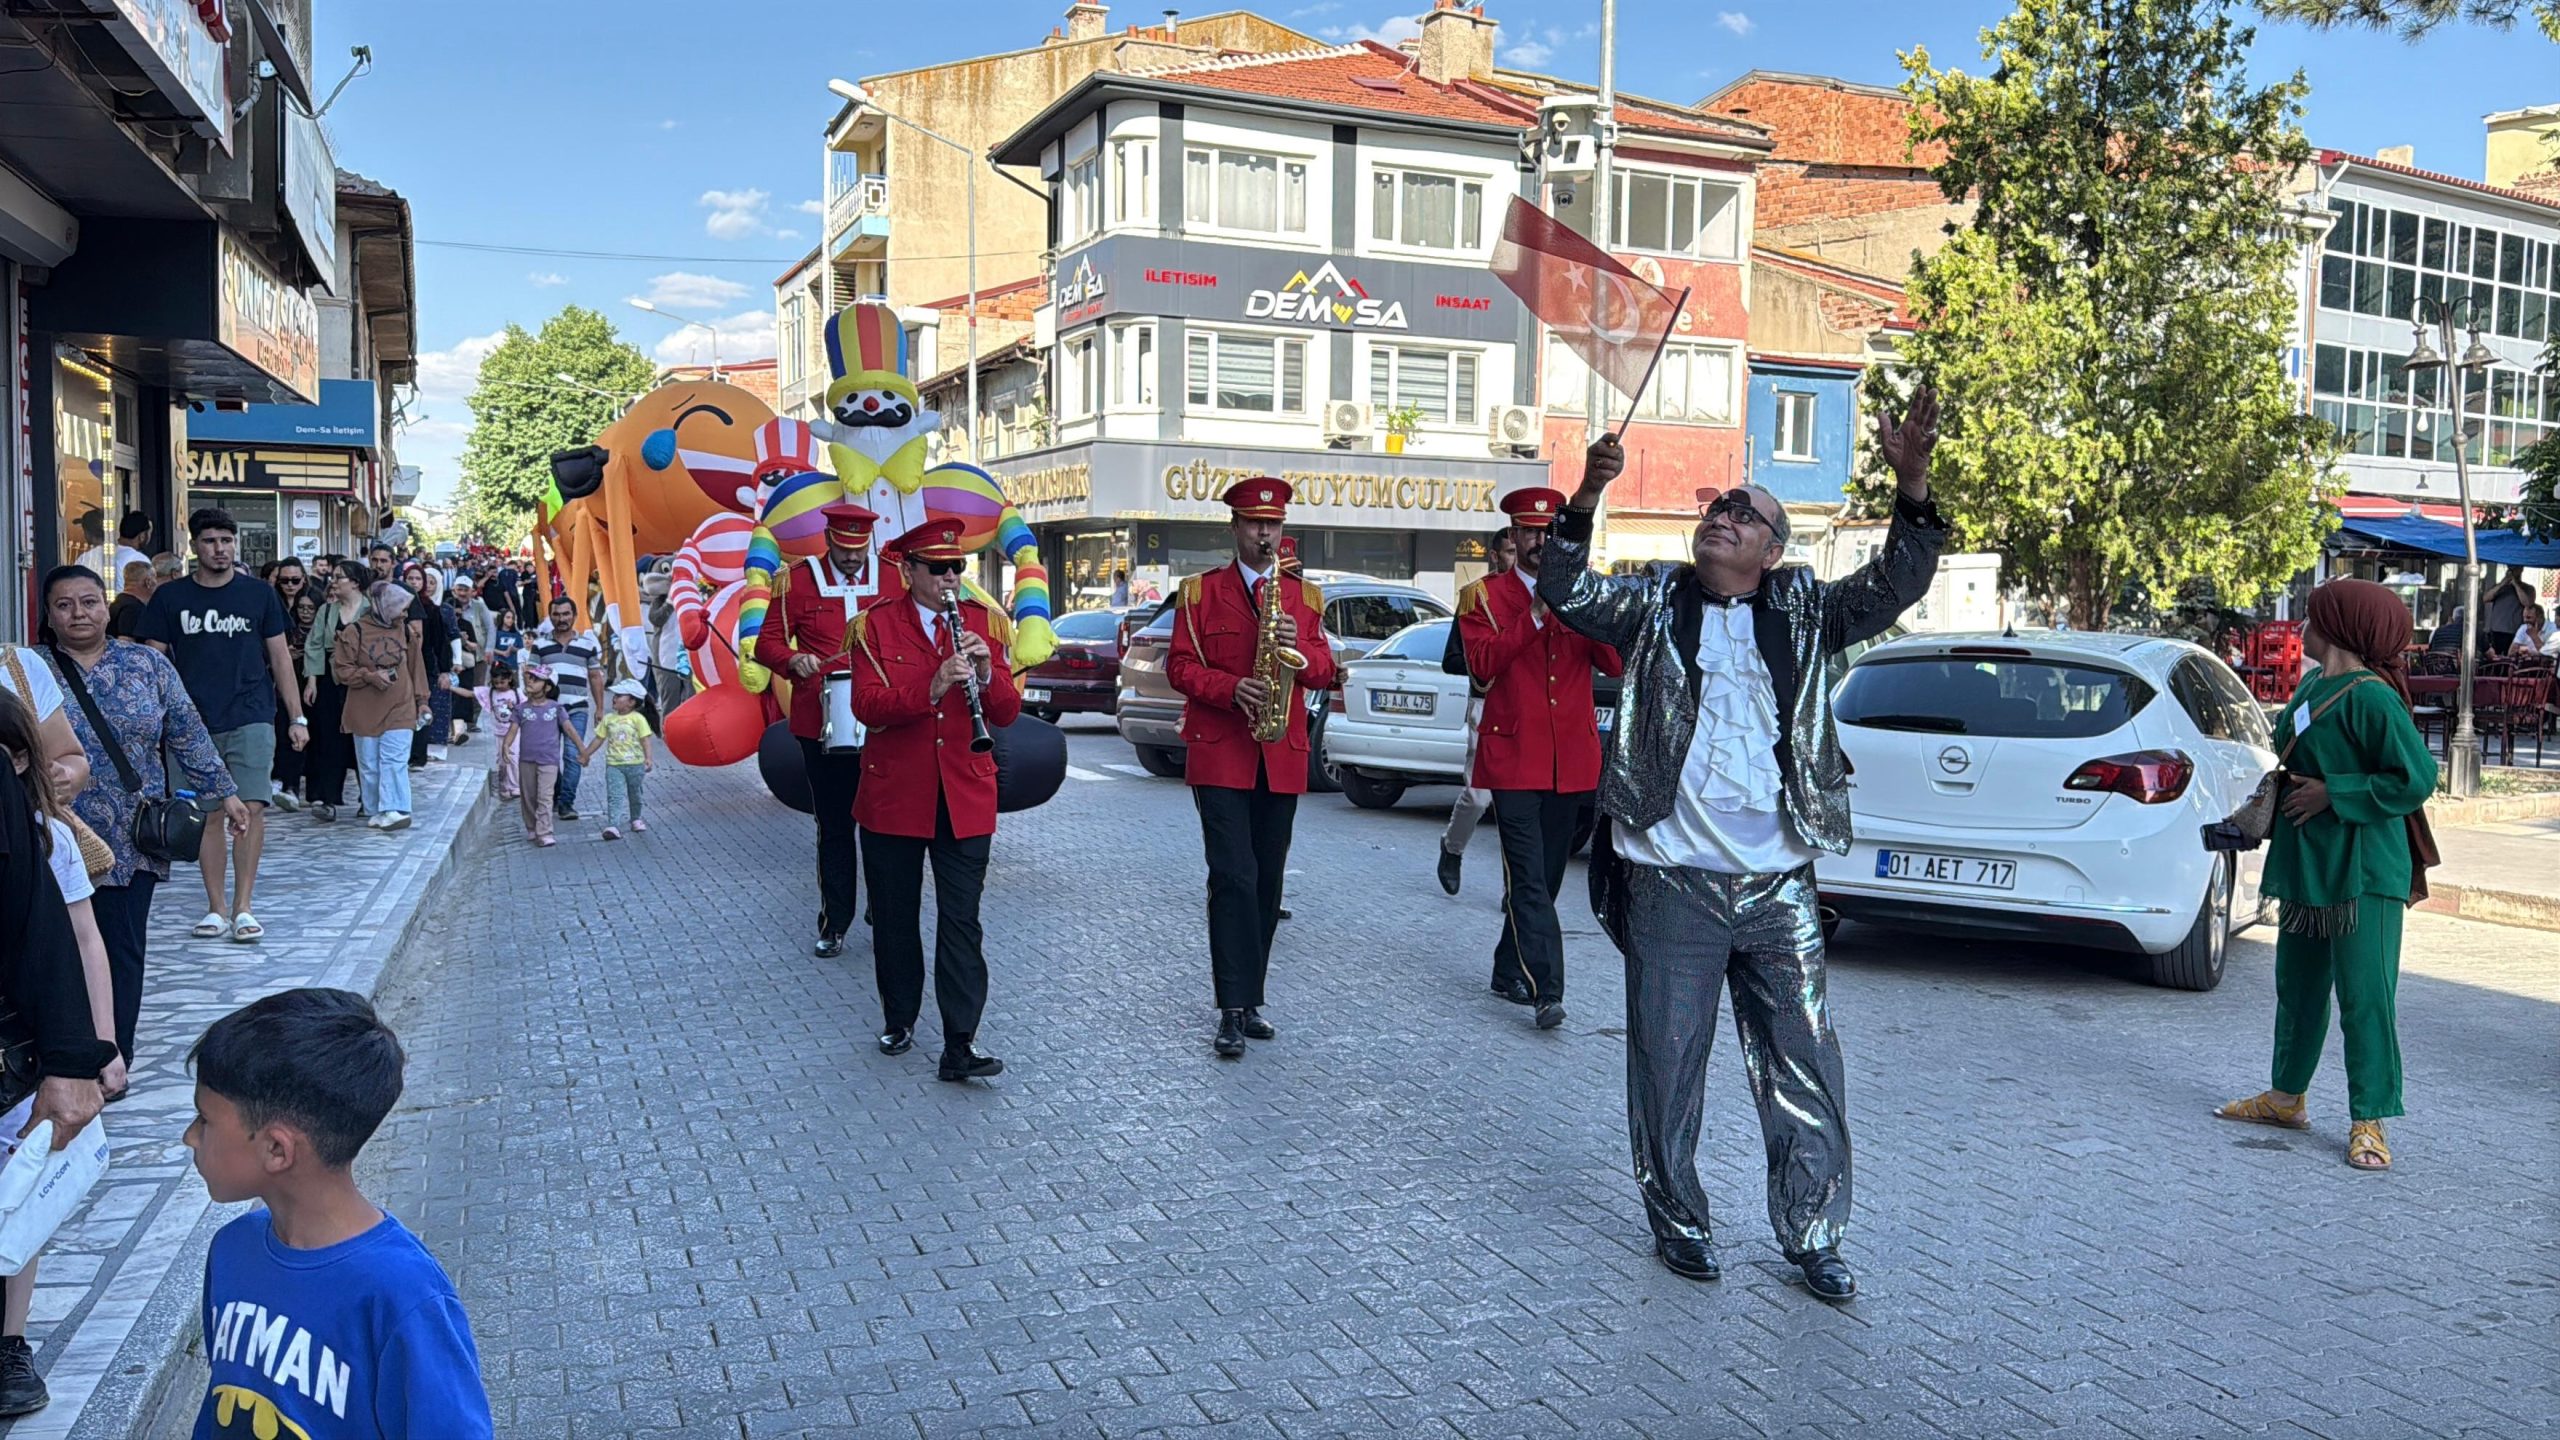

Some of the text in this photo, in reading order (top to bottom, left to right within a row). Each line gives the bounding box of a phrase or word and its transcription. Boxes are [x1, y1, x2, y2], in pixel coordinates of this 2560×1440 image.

[1282, 470, 1497, 512] KUYUMCULUK
[180, 609, 252, 638] Lee Cooper
[1377, 693, 1431, 710] 03 AJK 475
[2055, 796, 2092, 805] TURBO
[1889, 854, 1910, 876] 01
[1924, 857, 1964, 881] AET
[1976, 861, 2013, 885] 717
